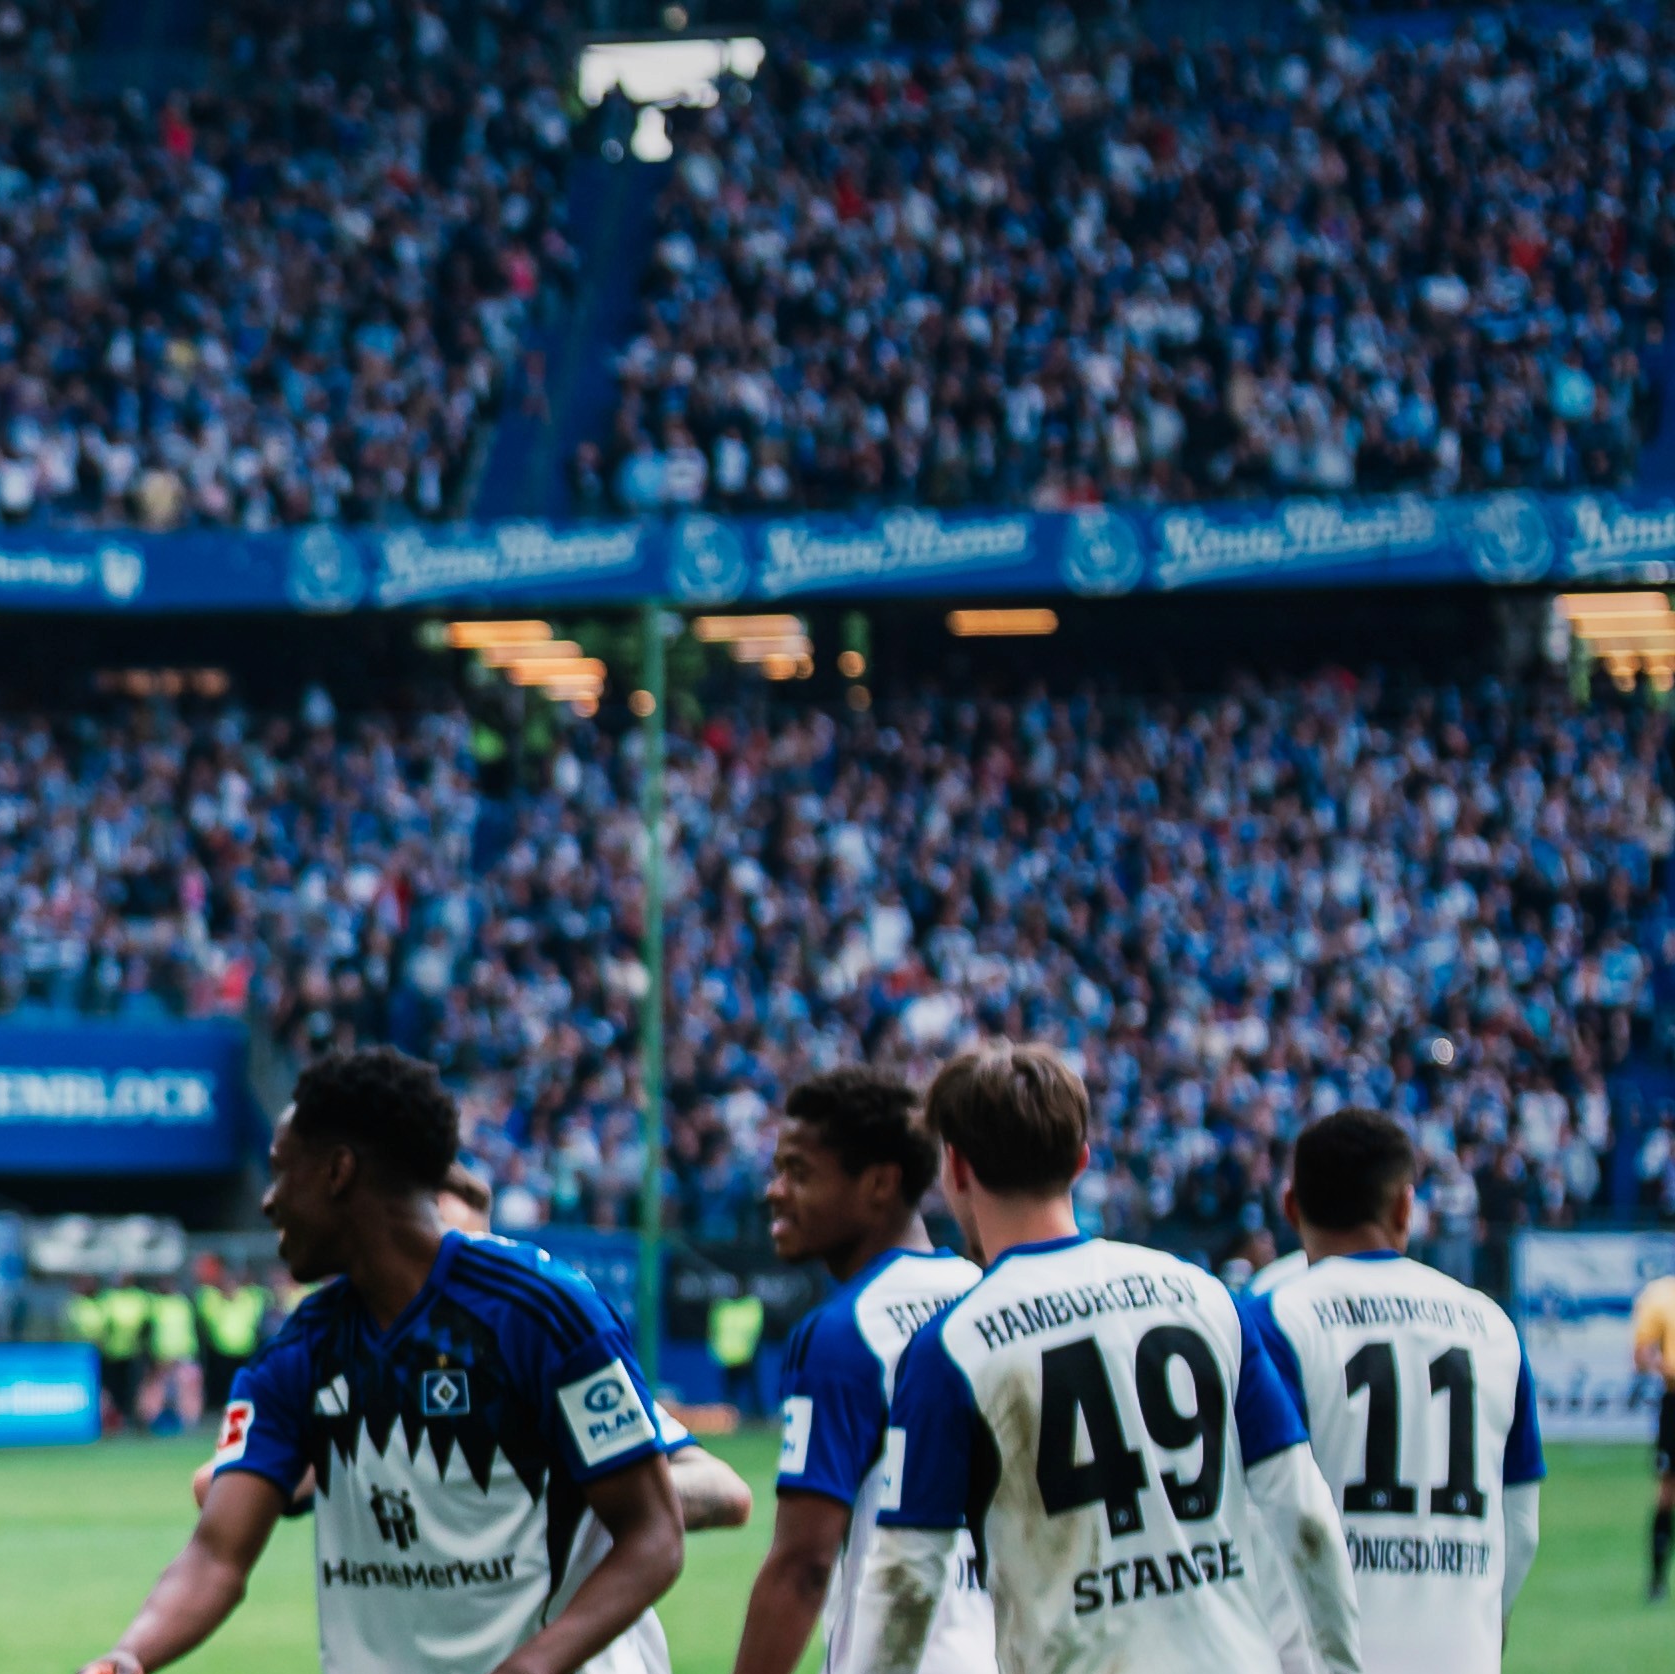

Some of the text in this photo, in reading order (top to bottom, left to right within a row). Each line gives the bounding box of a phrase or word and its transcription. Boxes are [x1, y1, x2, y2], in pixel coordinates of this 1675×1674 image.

[974, 1273, 1158, 1351] HAMBURGER
[1037, 1325, 1227, 1540] 49
[1344, 1340, 1487, 1518] 11
[1073, 1538, 1245, 1615] STANGE
